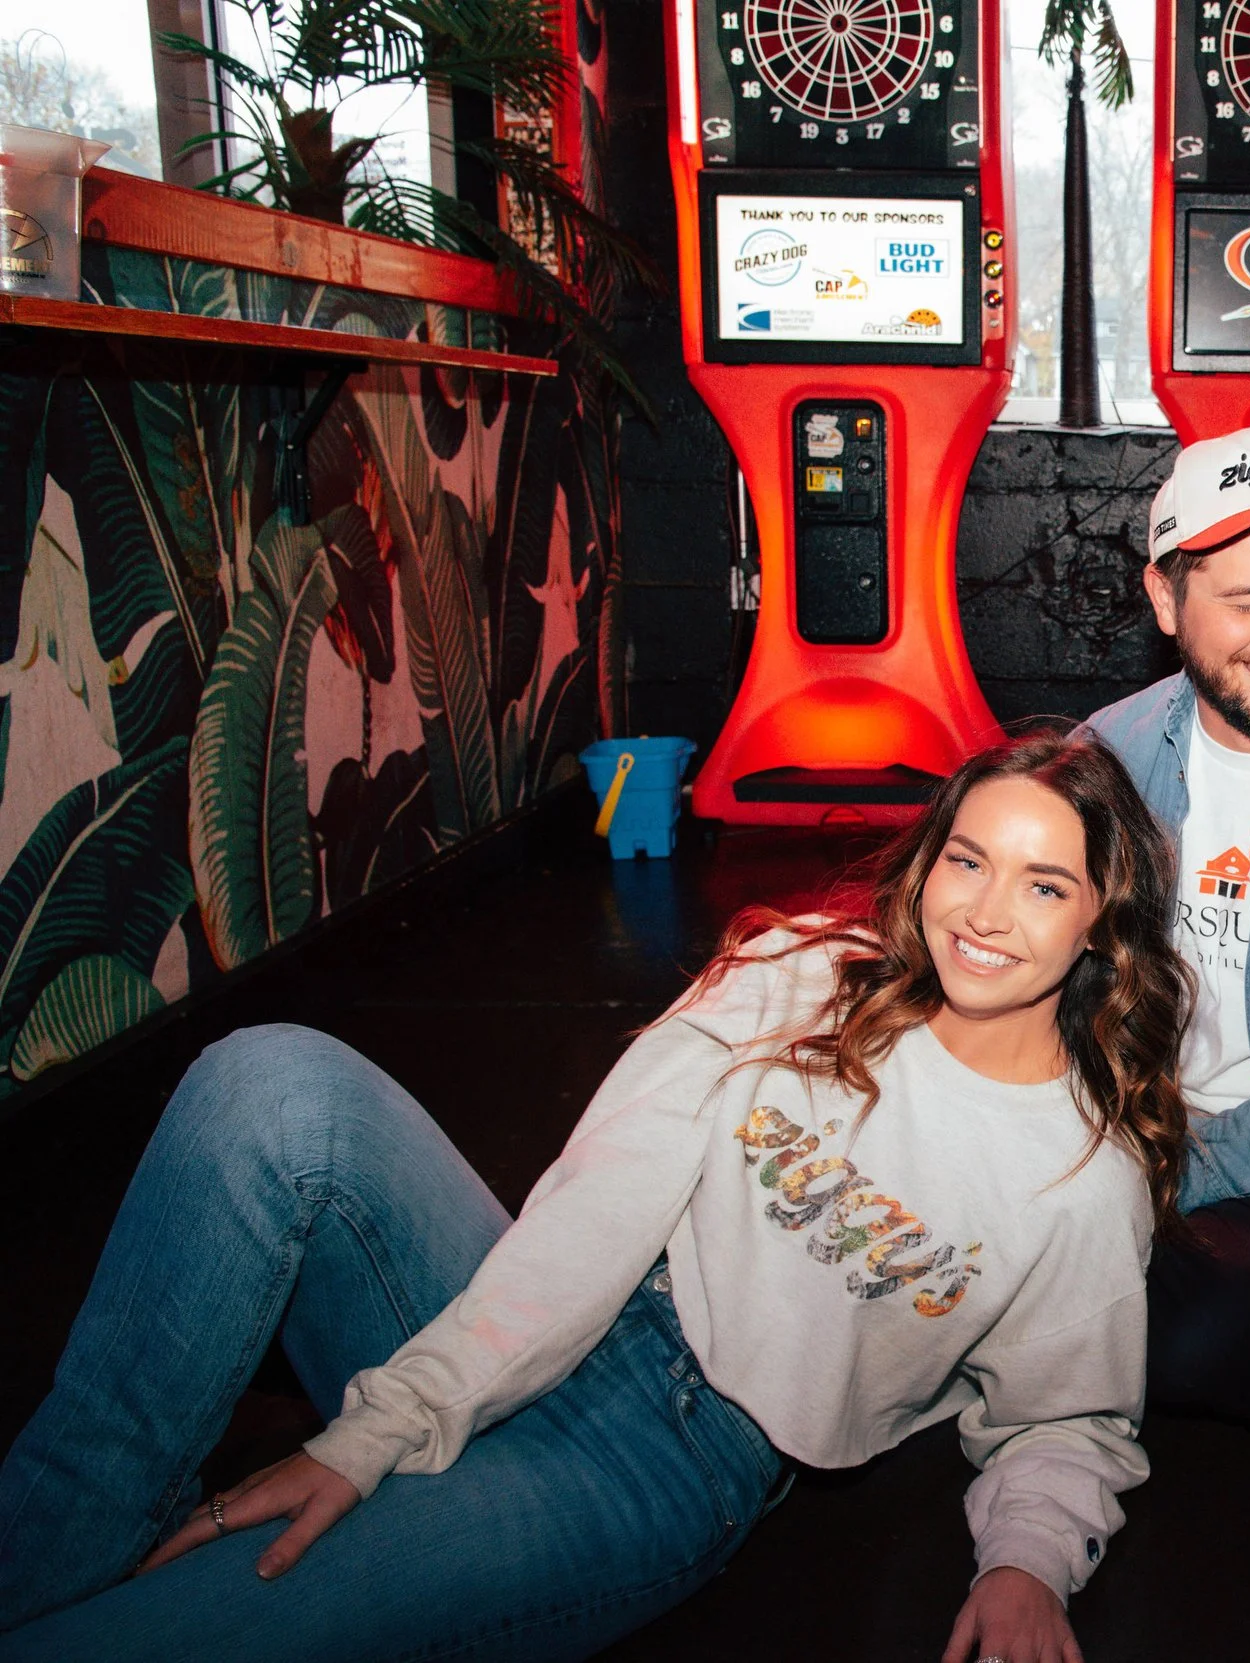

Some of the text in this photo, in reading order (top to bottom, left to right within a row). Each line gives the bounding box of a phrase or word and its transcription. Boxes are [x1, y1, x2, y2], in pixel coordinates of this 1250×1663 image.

[1203, 3, 1221, 19] 14
[722, 14, 739, 29] 11
[940, 16, 953, 33] 6
[1200, 37, 1216, 52] 11
[730, 48, 744, 65] 8
[934, 51, 954, 68] 10
[1206, 70, 1219, 87] 8
[742, 81, 762, 98] 16
[920, 83, 940, 100] 15
[769, 106, 783, 123] 7
[898, 107, 910, 124] 2
[1216, 102, 1234, 119] 16
[800, 123, 819, 140] 19
[836, 129, 849, 145] 3
[866, 123, 885, 140] 17
[741, 209, 944, 225] THANK YOU TO OUR SPONSORS
[735, 250, 778, 272] CRAZY
[782, 243, 808, 261] DOG
[889, 243, 935, 257] BUD
[880, 258, 944, 273] LIGHT
[815, 280, 842, 293] CAP
